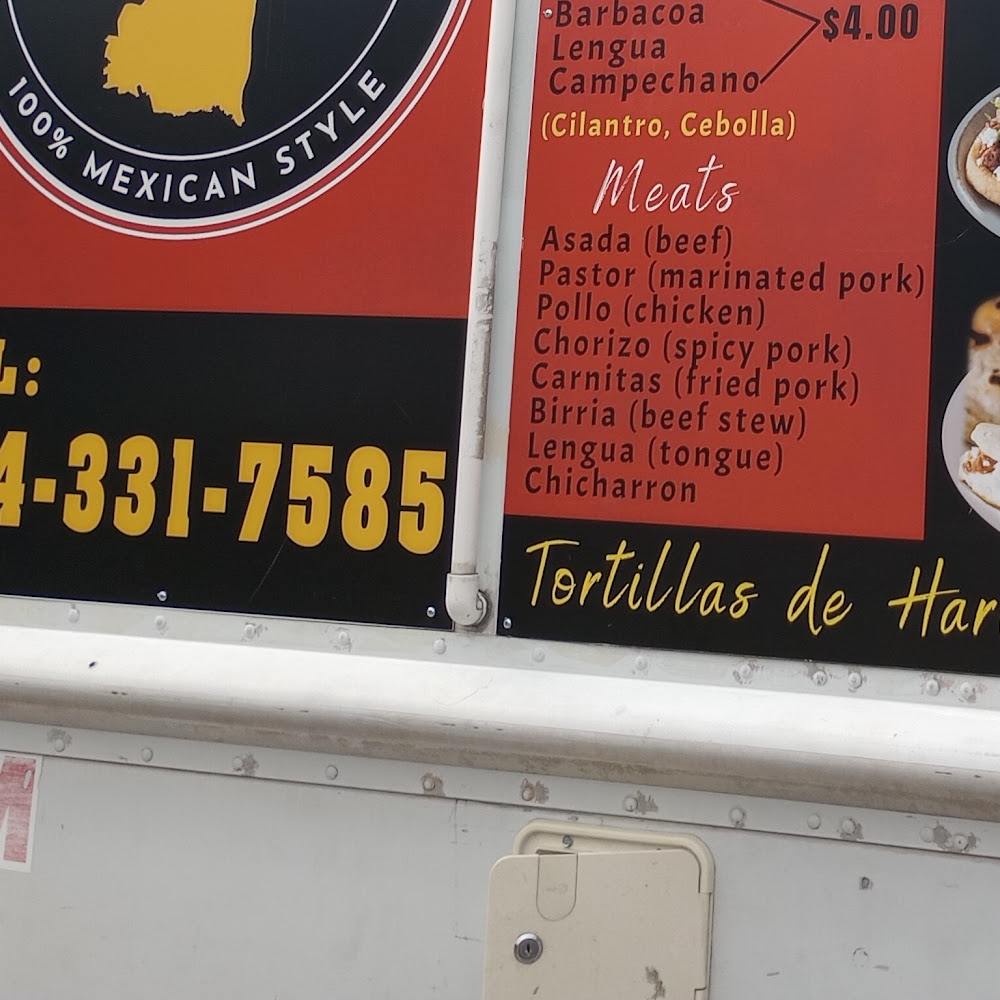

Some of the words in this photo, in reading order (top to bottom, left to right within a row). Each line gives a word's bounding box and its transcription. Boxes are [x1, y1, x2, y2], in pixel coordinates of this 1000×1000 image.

[822, 2, 920, 42] $4.00
[552, 33, 667, 68] Lengua
[549, 62, 760, 102] Campechano
[8, 76, 74, 160] 100%
[82, 150, 257, 202] MEXICAN
[275, 68, 387, 176] STYLE
[541, 110, 671, 141] (Cilantro,
[681, 109, 797, 140] Cebolla)
[592, 154, 740, 215] Meats
[540, 224, 631, 253] Asada
[643, 224, 733, 258] (beef)
[539, 259, 636, 288] Pastor
[648, 260, 826, 293] (marinated
[838, 262, 926, 299] pork)
[537, 291, 611, 322] Pollo
[623, 293, 766, 330] (chicken)
[533, 327, 650, 359] Chorizo
[662, 330, 755, 369] (spicy
[766, 333, 852, 370] pork)
[531, 361, 661, 395] Carnitas
[673, 364, 761, 399] (fried
[773, 369, 860, 406] pork)
[530, 396, 616, 427] Birria
[628, 399, 709, 433] (beef
[718, 405, 807, 440] stew)
[528, 431, 634, 469] Lengua
[647, 435, 784, 477] (tongue)
[524, 465, 697, 503] Chicharron
[526, 538, 758, 622] Tortillas
[786, 542, 853, 636] de
